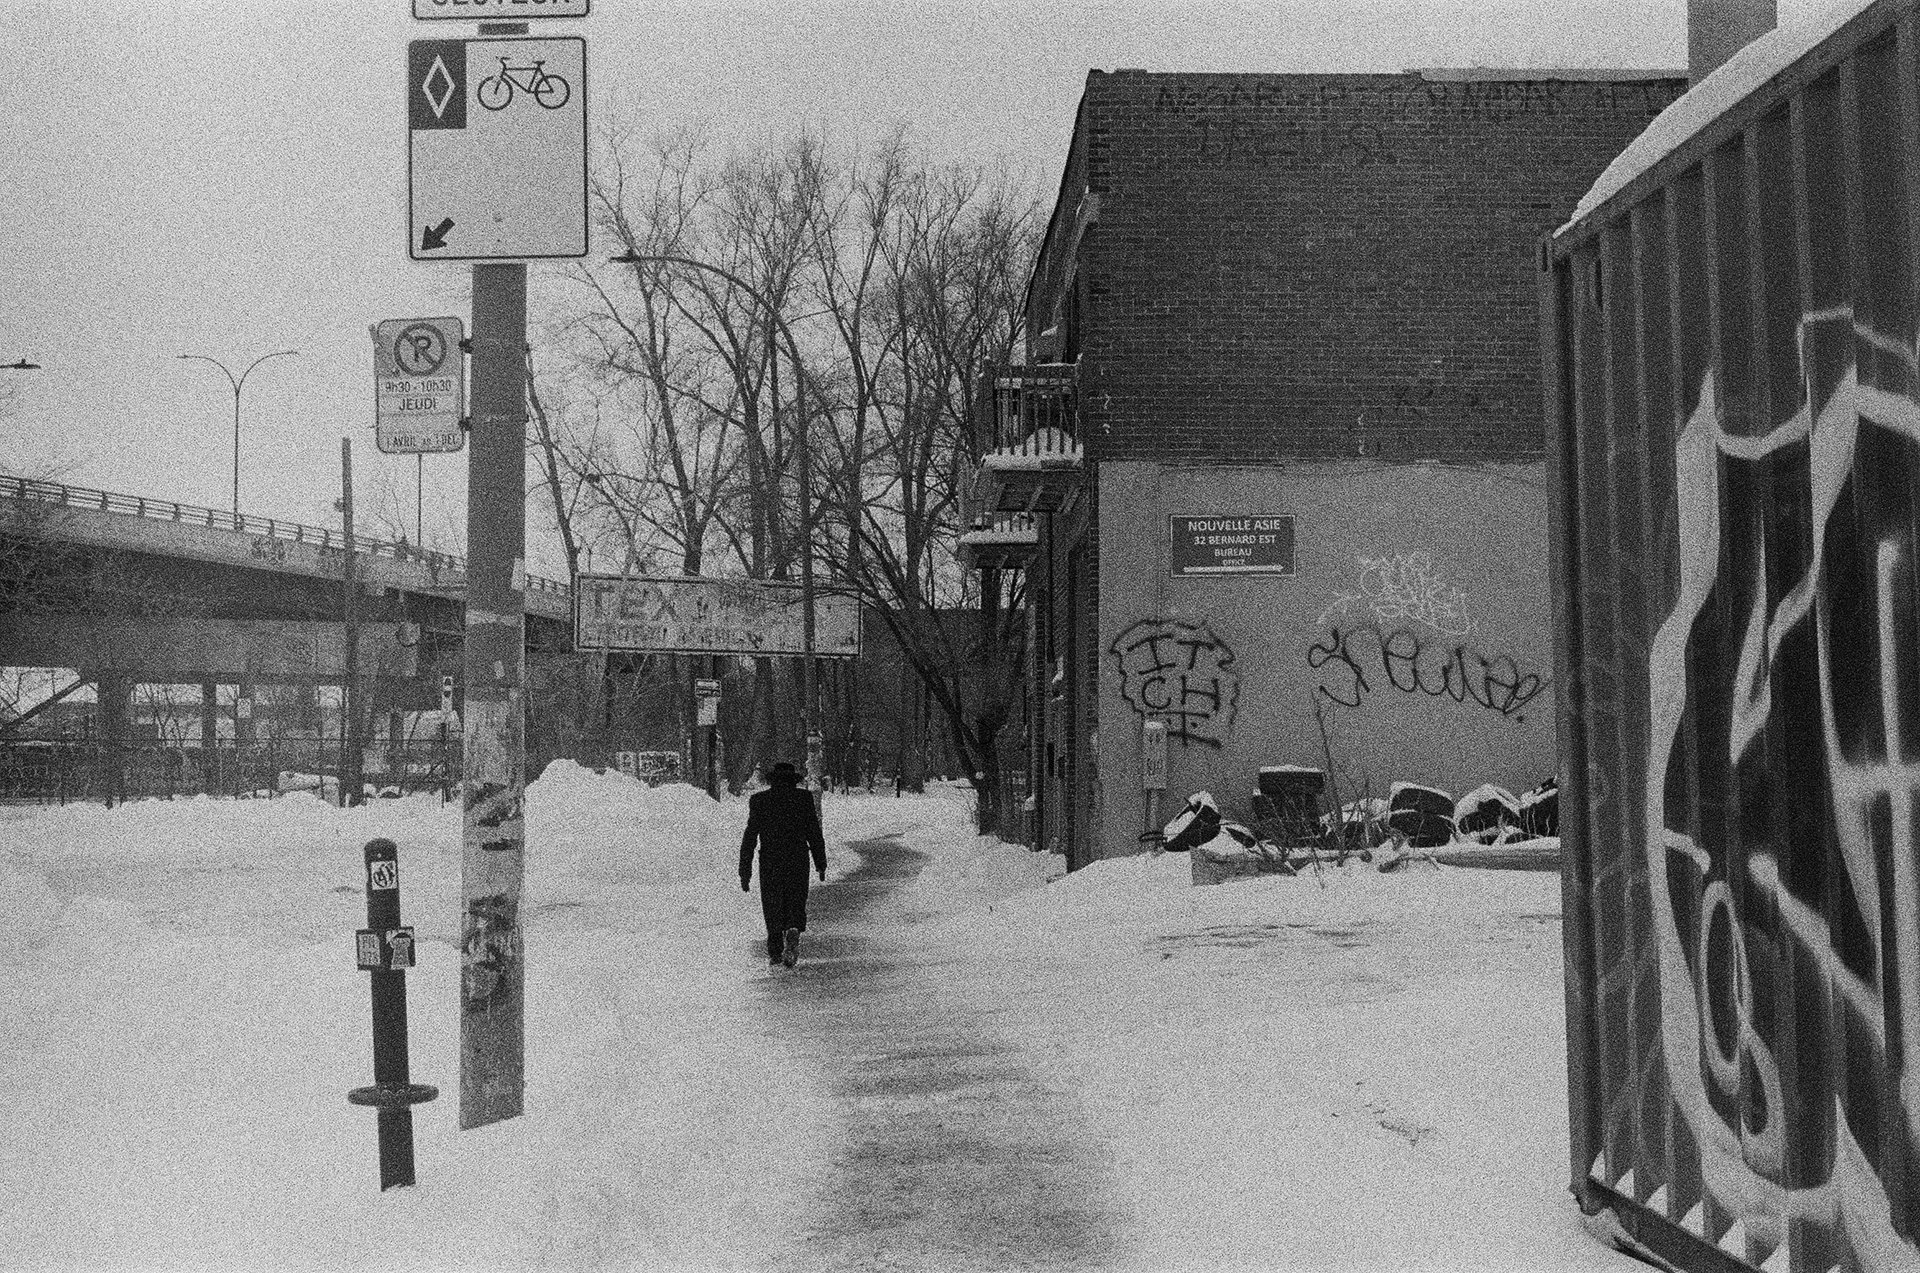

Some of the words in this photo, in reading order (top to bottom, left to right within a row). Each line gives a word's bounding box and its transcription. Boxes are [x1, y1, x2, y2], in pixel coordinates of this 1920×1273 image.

[421, 379, 451, 393] 10h30
[398, 397, 437, 412] JEUDI
[393, 435, 417, 447] AVRIL
[1188, 519, 1251, 532] NOUVELLE
[1254, 518, 1281, 531] ASIE
[1194, 535, 1206, 545] 32
[1208, 534, 1256, 545] BERNARD
[1259, 534, 1277, 544] EST
[1214, 548, 1252, 557] BUREAU
